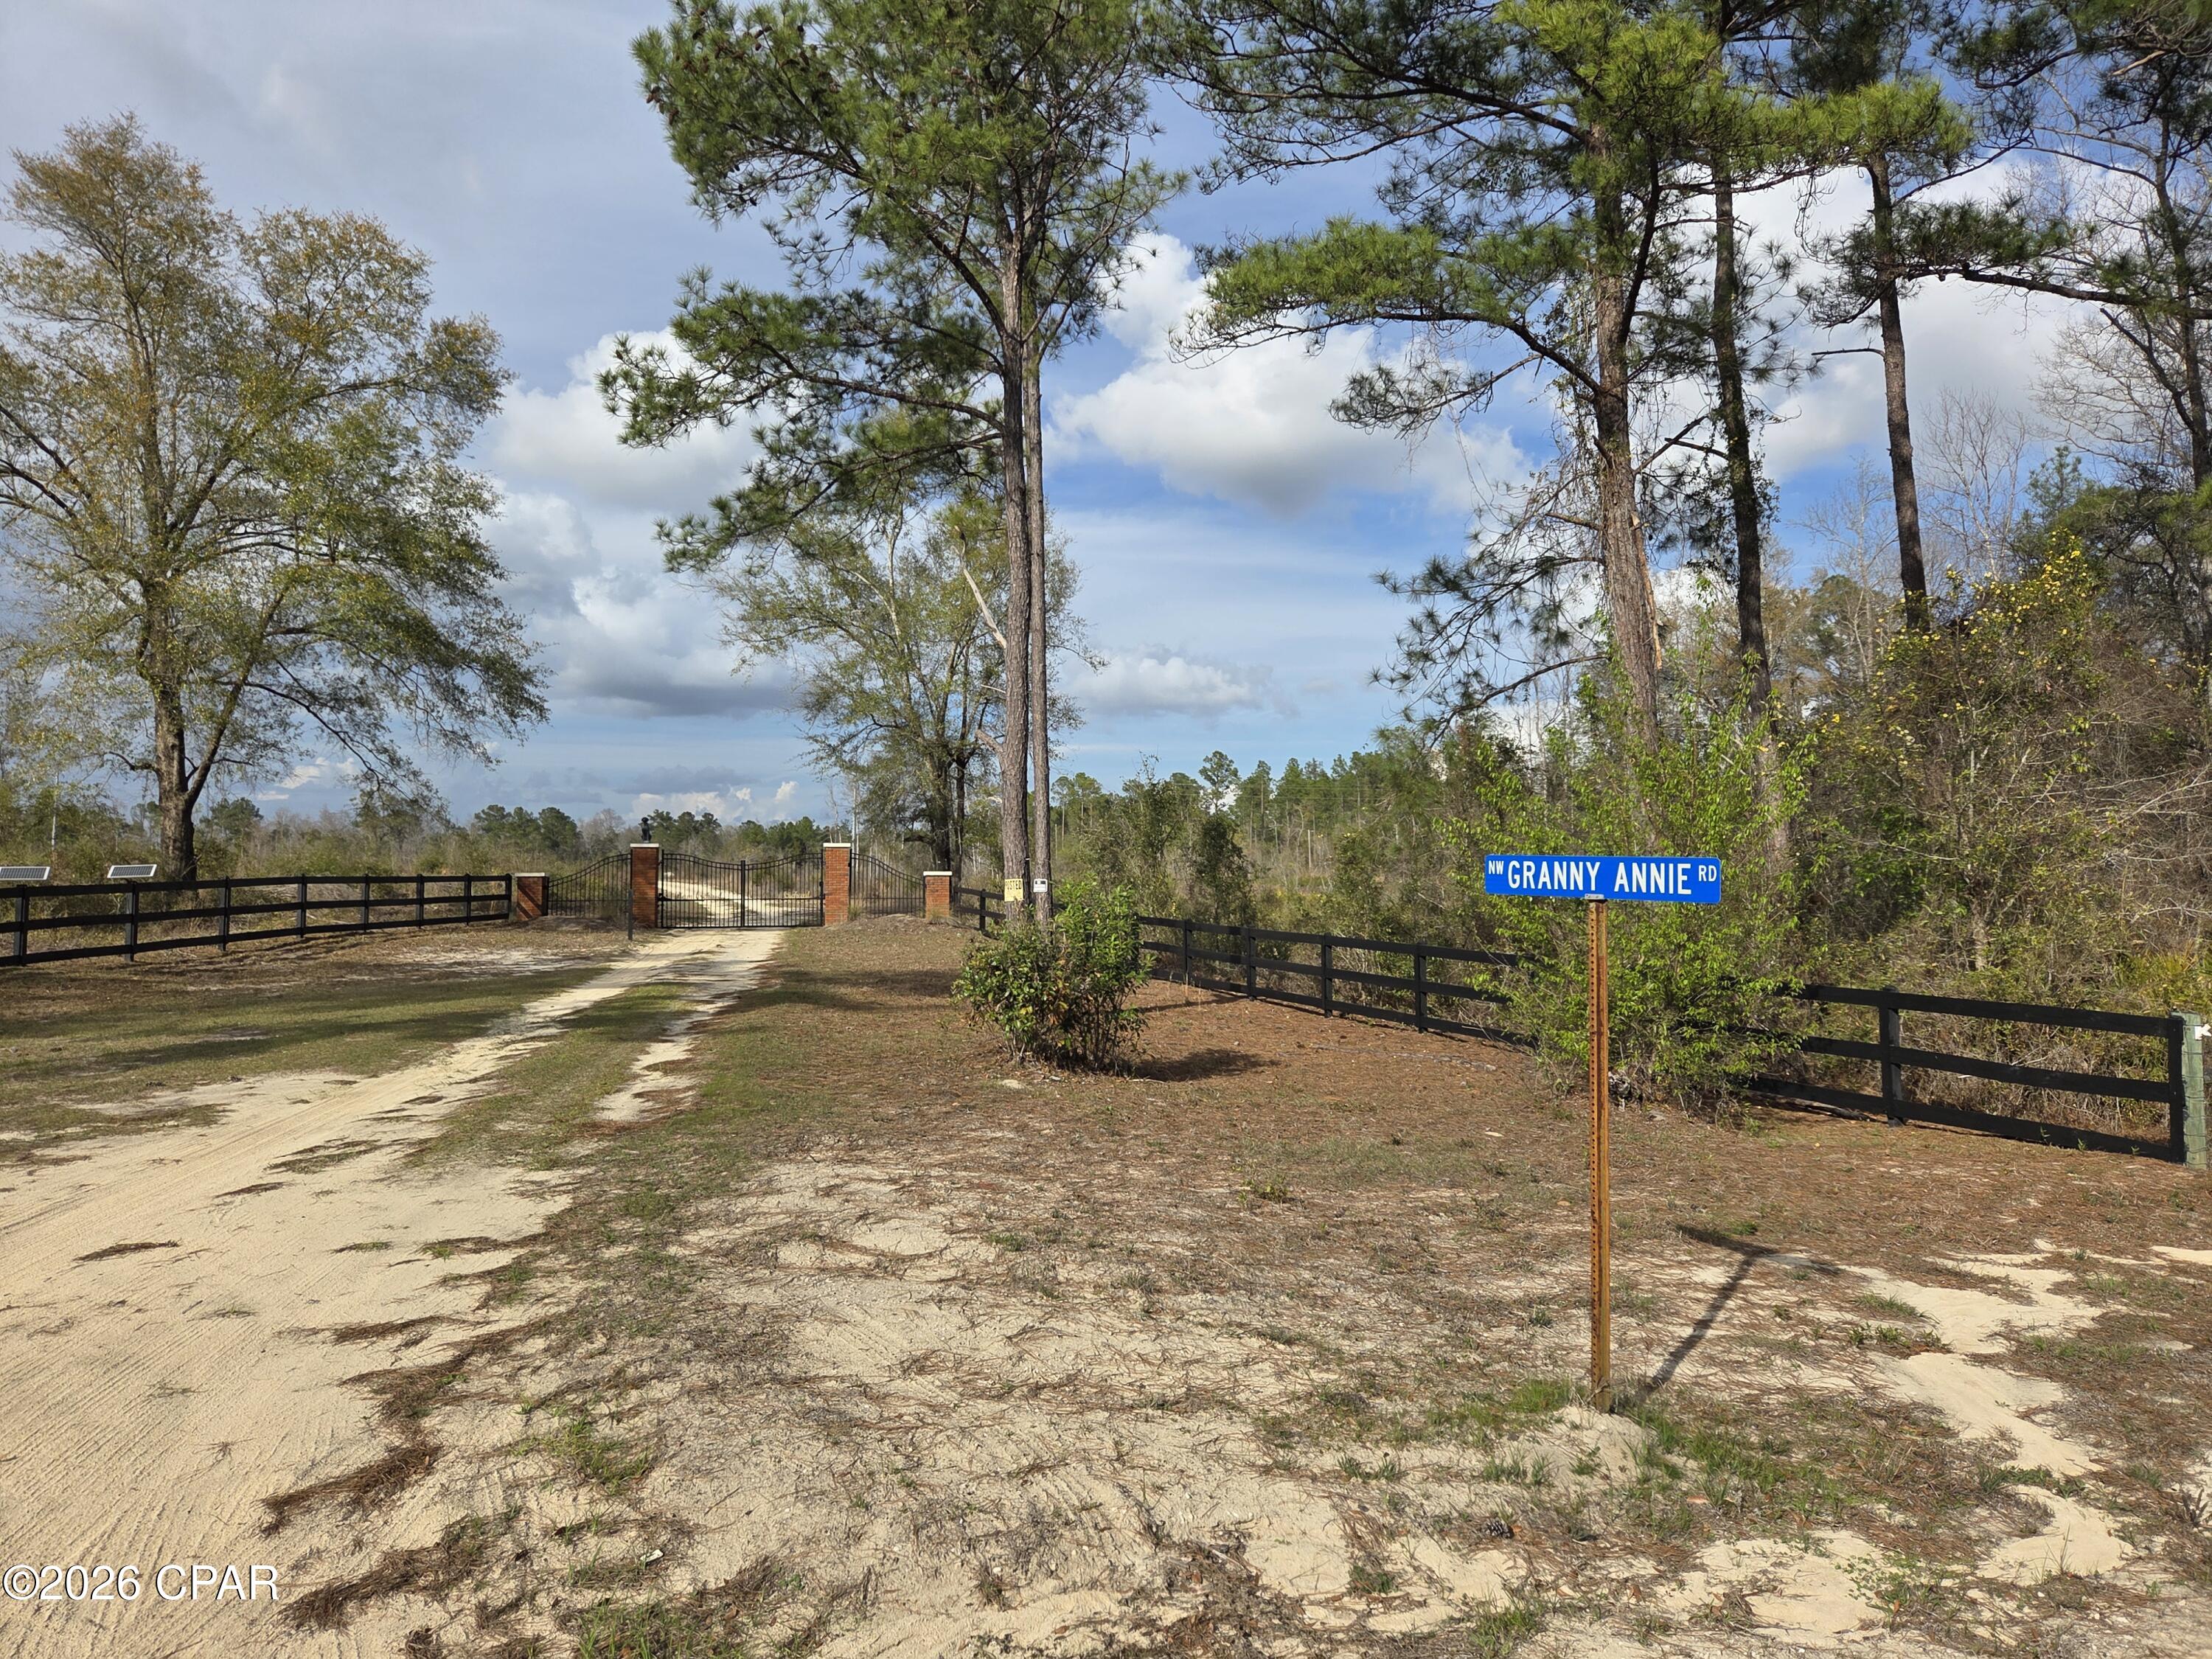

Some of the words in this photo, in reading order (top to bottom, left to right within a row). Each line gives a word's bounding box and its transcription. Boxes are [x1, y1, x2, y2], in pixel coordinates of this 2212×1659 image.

[1488, 860, 1504, 875] NW
[1508, 860, 1601, 891] GRANNY
[1614, 862, 1692, 894] ANNIE
[1698, 865, 1717, 882] RD
